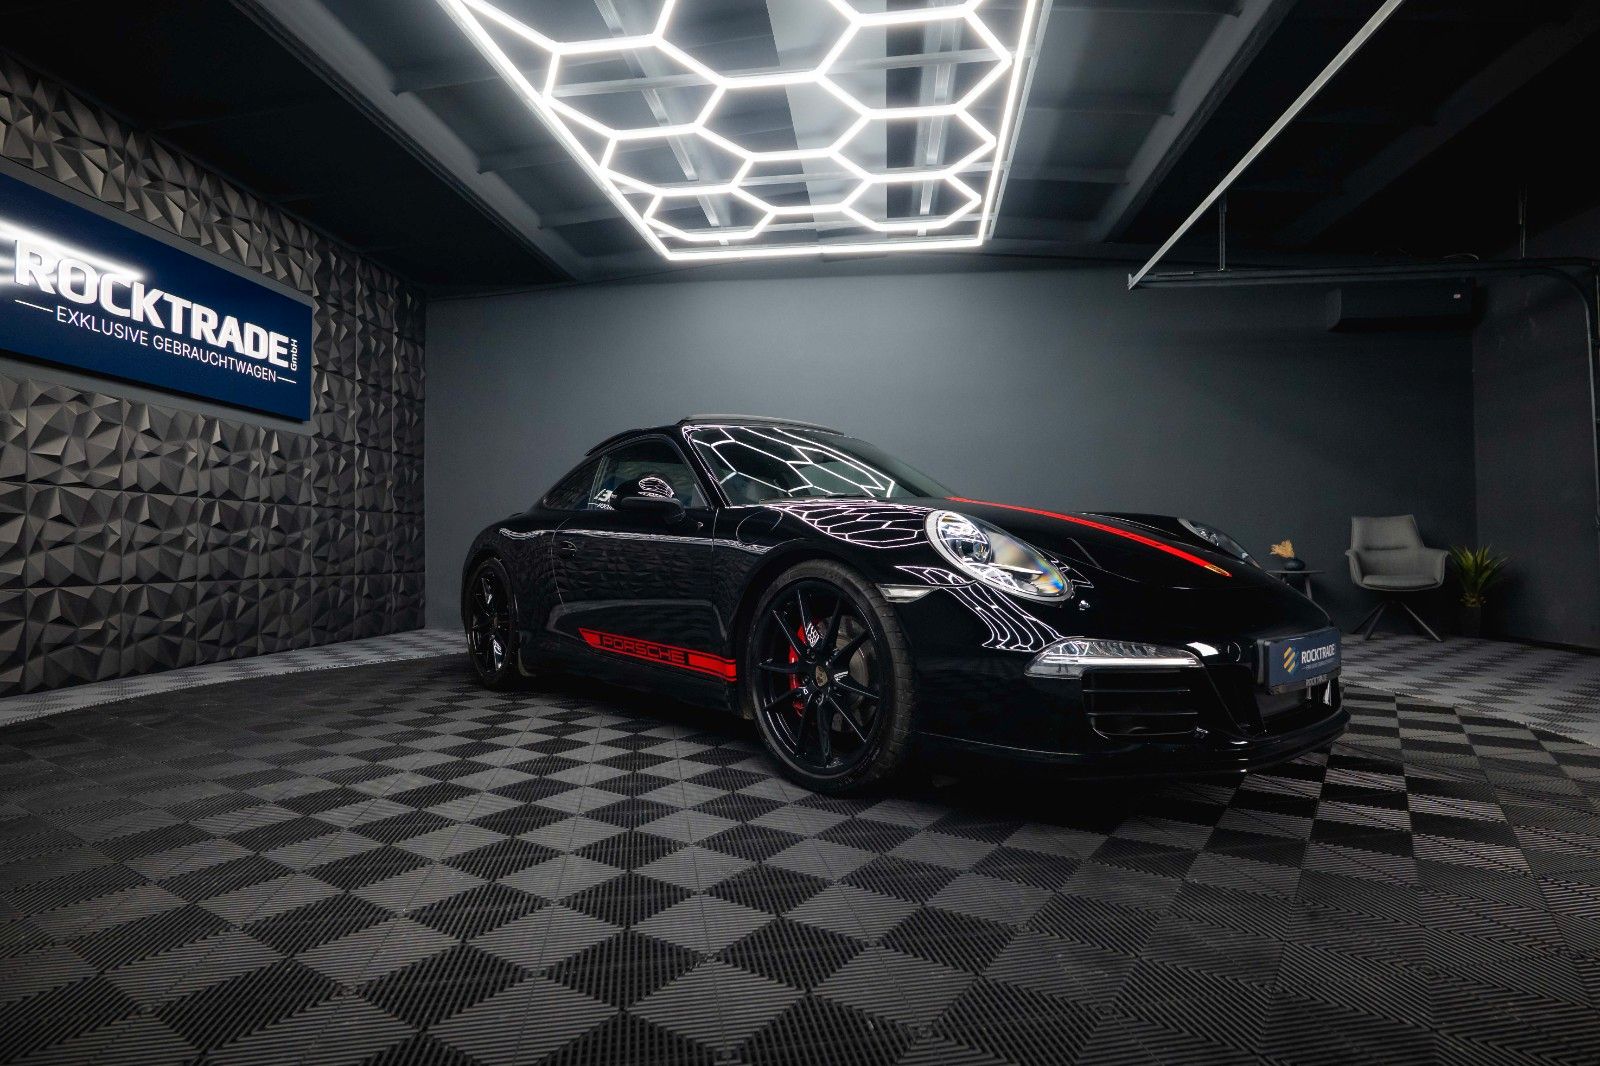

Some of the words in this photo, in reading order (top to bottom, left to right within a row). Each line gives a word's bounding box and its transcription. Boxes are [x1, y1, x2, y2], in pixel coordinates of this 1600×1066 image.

[14, 239, 290, 368] ROCKTRADE
[56, 305, 149, 347] EXKLUSIVE
[152, 334, 277, 383] GEBRAUCHTWAGEN
[290, 338, 298, 372] GmbH
[602, 635, 686, 664] PORSCHE
[1301, 644, 1335, 663] ROCKTRADE
